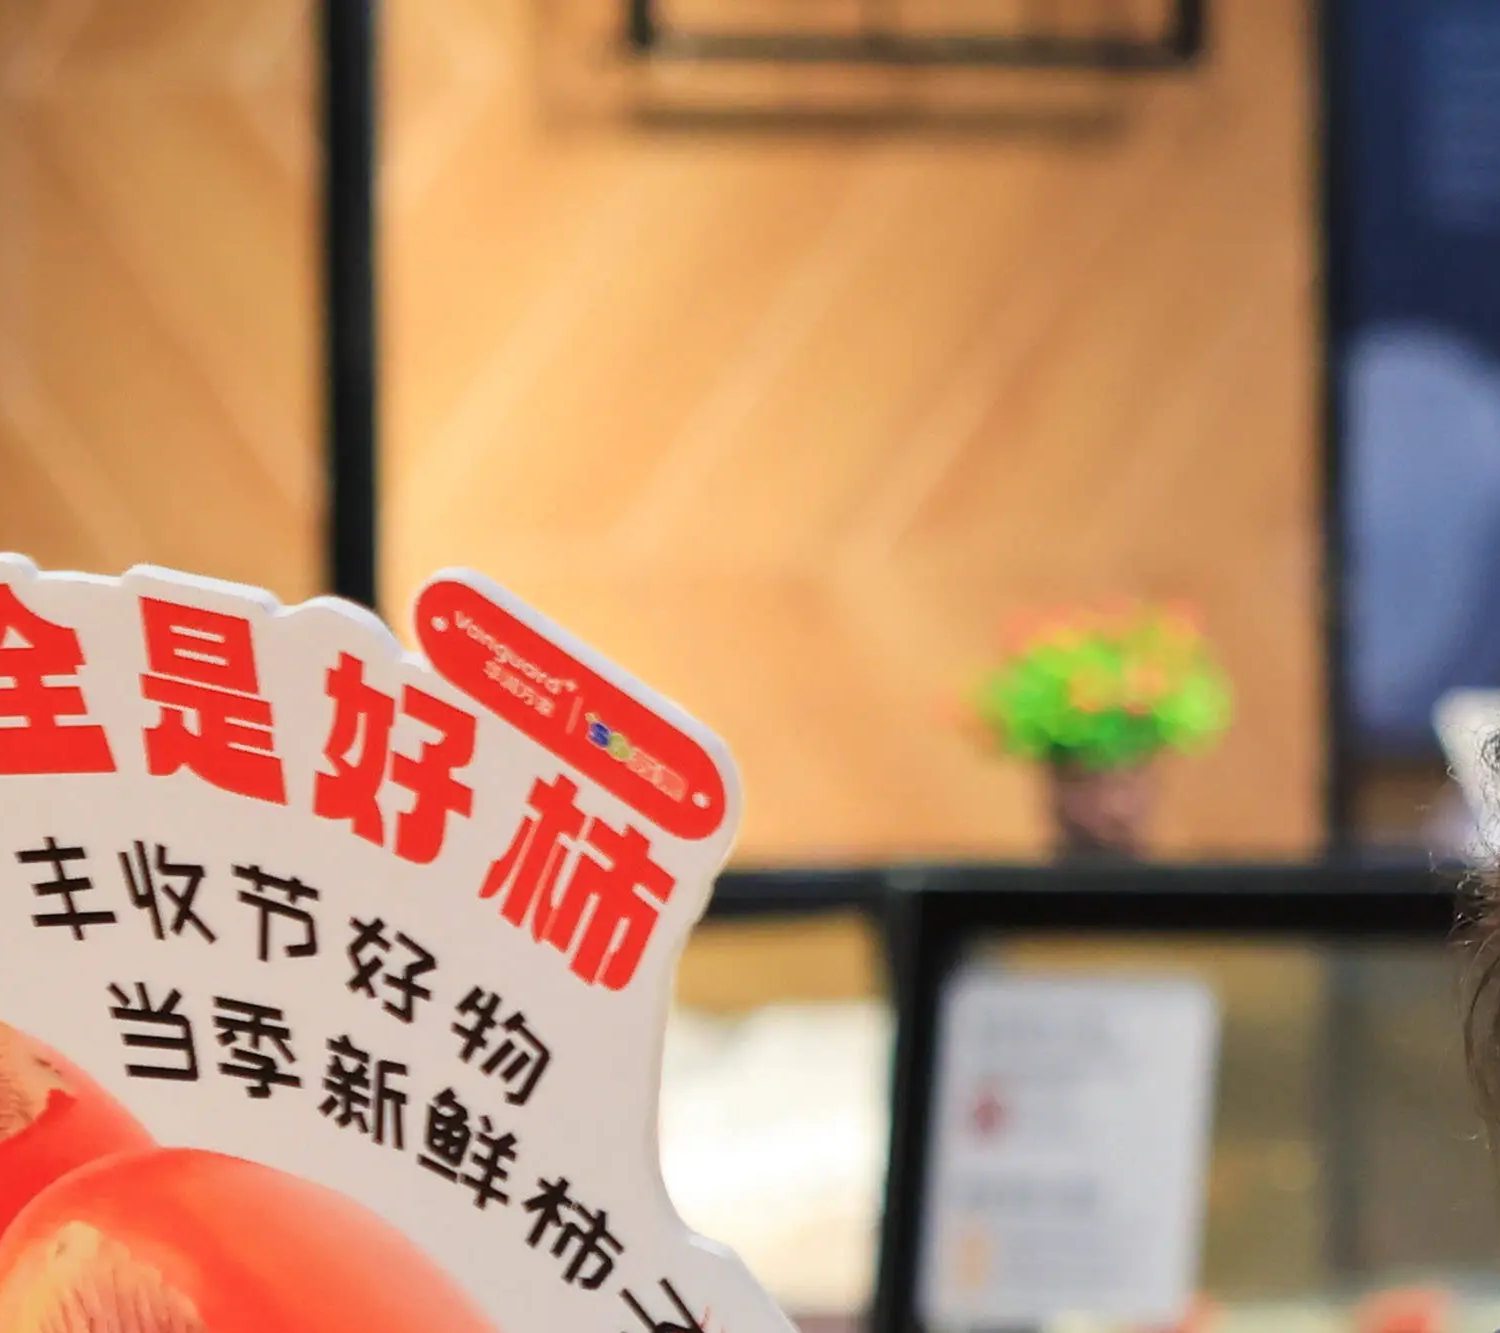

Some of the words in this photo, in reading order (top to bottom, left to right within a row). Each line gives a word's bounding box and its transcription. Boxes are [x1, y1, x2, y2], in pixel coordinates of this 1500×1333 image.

[16, 836, 553, 1107] 丰收节好物
